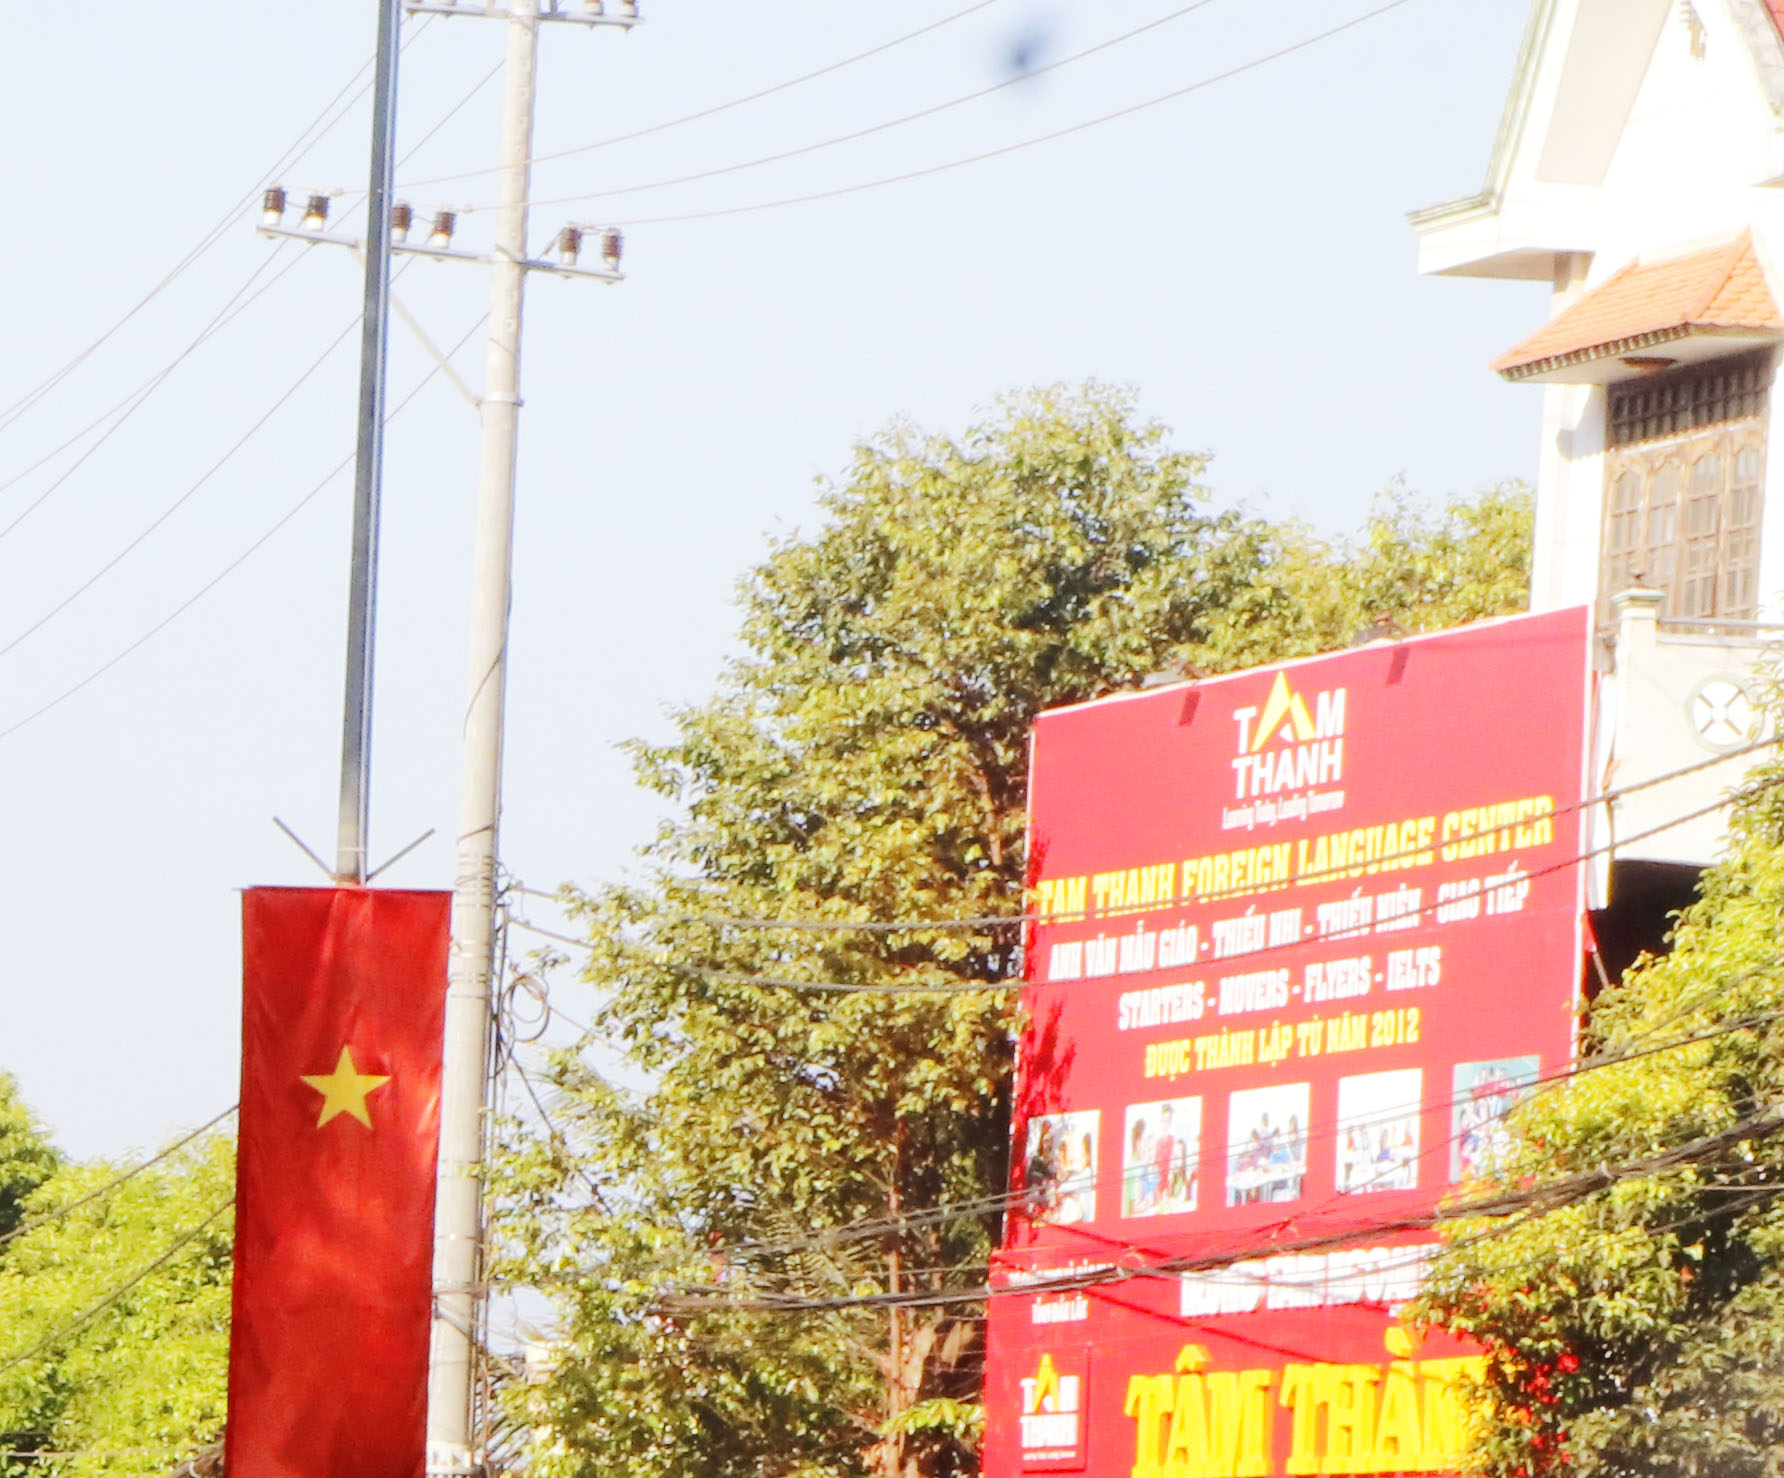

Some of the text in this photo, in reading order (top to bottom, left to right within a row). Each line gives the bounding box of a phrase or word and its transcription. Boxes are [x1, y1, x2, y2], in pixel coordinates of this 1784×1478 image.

[1232, 738, 1342, 799] THANH
[1039, 795, 1553, 925] TAM THANH FOREIGN LANGUAGE CENTER
[1049, 942, 1083, 981] ANH
[1158, 921, 1198, 969] GIÁO
[1270, 908, 1302, 948] NHI
[1118, 981, 1204, 1030] STARTERS
[1218, 968, 1289, 1015] MOVERS
[1303, 956, 1372, 1003] FLYERS
[1386, 946, 1441, 992] IELTS
[1144, 1039, 1189, 1081] ĐƯỢC
[1195, 1027, 1254, 1070] THÀNH
[1371, 1008, 1419, 1049] 2012
